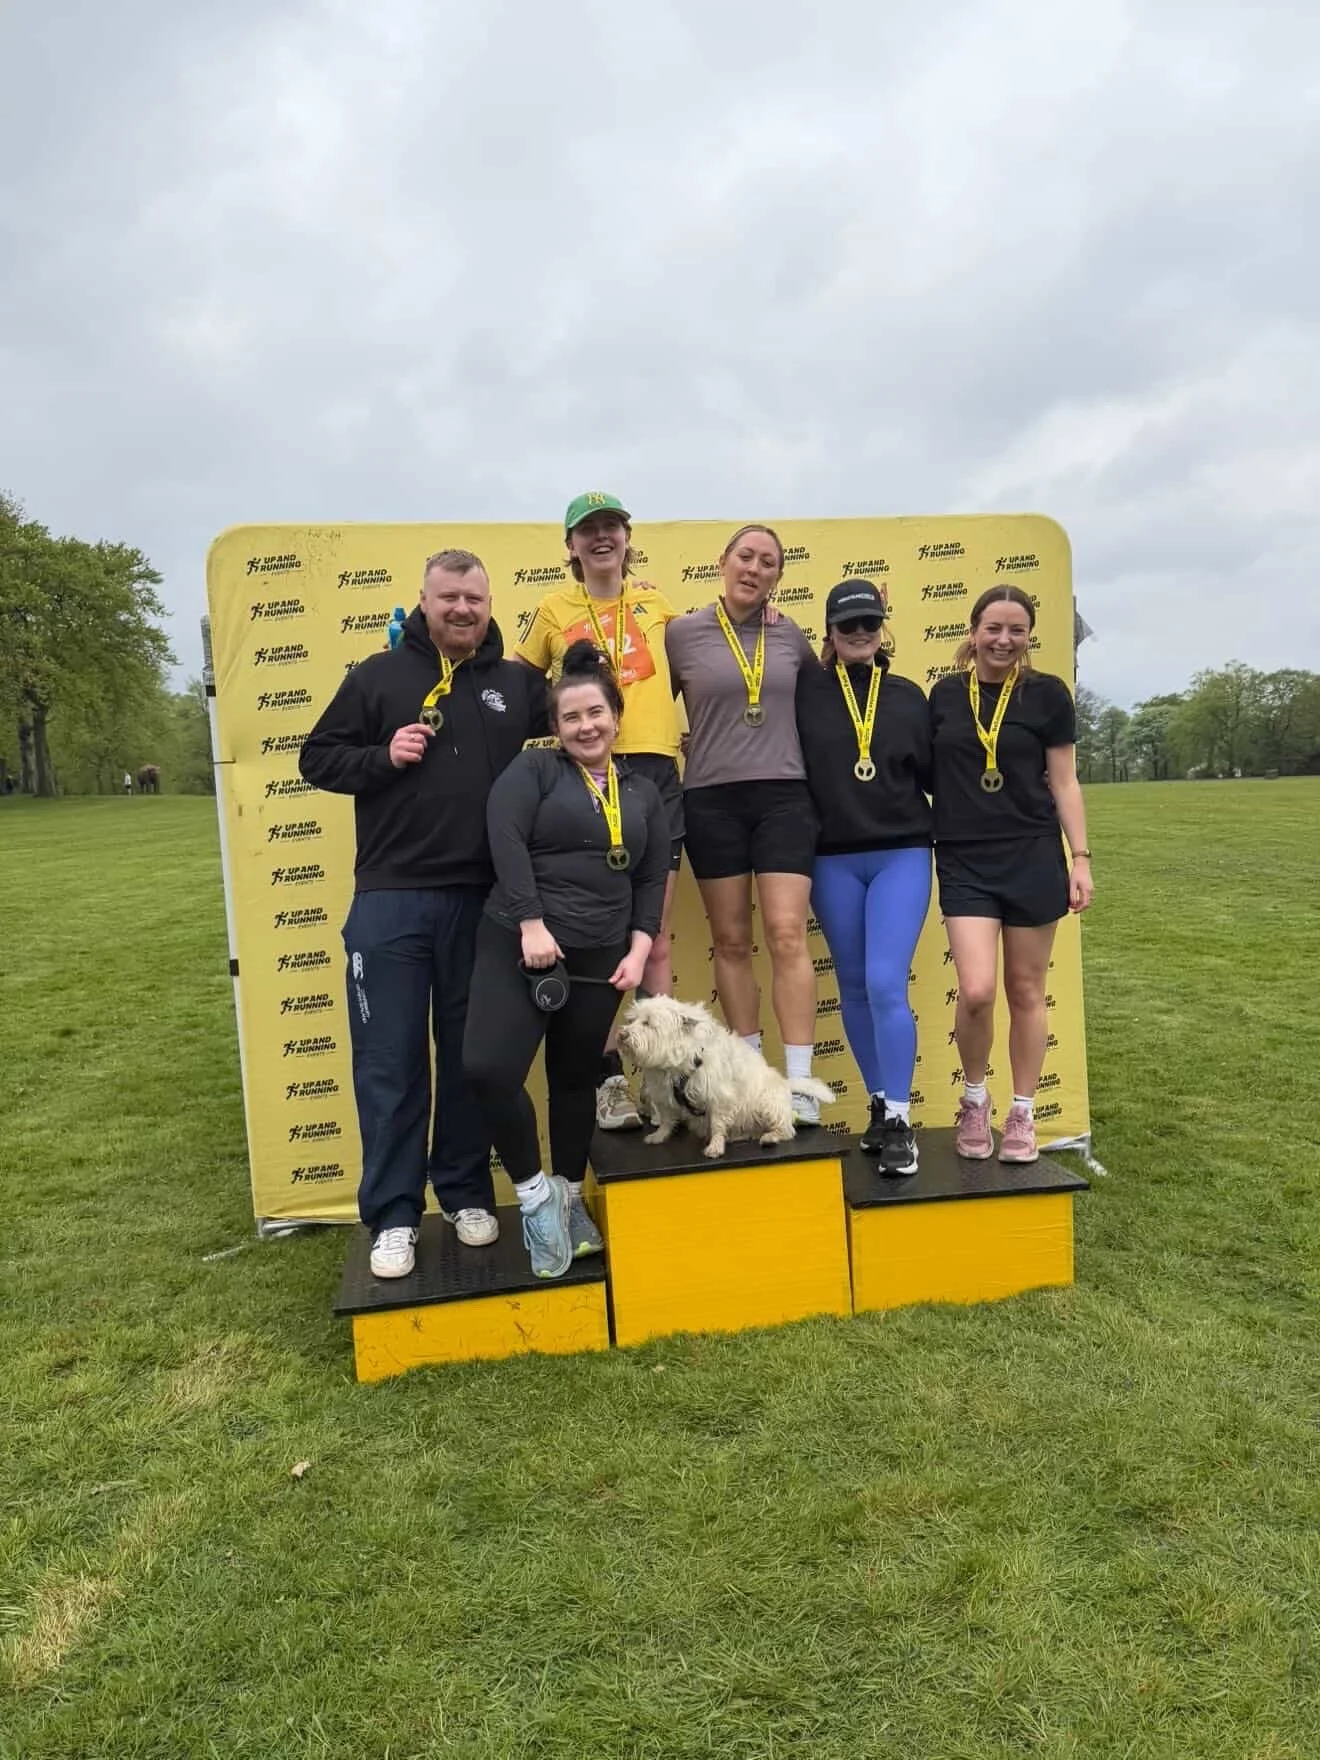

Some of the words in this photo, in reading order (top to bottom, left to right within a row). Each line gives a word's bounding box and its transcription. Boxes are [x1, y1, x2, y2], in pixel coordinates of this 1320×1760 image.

[930, 548, 965, 557] RUNNING
[277, 554, 296, 562] AND
[261, 561, 301, 571] RUNNING
[1006, 560, 1039, 569] RUNNING
[854, 565, 889, 575] RUNNING
[352, 575, 392, 584] RUNNING
[527, 573, 566, 583] RUNNING
[776, 592, 814, 603] RUNNING
[933, 588, 967, 597] RUNNING
[280, 599, 300, 607] AND
[264, 606, 305, 616] RUNNING
[935, 628, 969, 638] RUNNING
[284, 644, 303, 652] AND
[268, 651, 308, 661] RUNNING
[287, 689, 307, 697] AND
[271, 695, 312, 706] RUNNING
[297, 820, 317, 829] AND
[282, 827, 322, 838] RUNNING
[300, 864, 320, 872] AND
[285, 871, 325, 881] RUNNING
[304, 907, 323, 916] AND
[288, 914, 328, 924] RUNNING
[307, 950, 326, 959] AND
[291, 957, 331, 967] RUNNING
[310, 993, 329, 1002] AND
[294, 1000, 334, 1010] RUNNING
[312, 1036, 331, 1044] AND
[297, 1042, 336, 1053] RUNNING
[315, 1079, 334, 1087] AND
[300, 1085, 339, 1095] RUNNING
[1034, 1108, 1062, 1120] RUNNING
[318, 1121, 336, 1129] AND
[302, 1128, 341, 1138] RUNNING
[320, 1163, 339, 1171] AND
[305, 1170, 344, 1180] RUNNING
